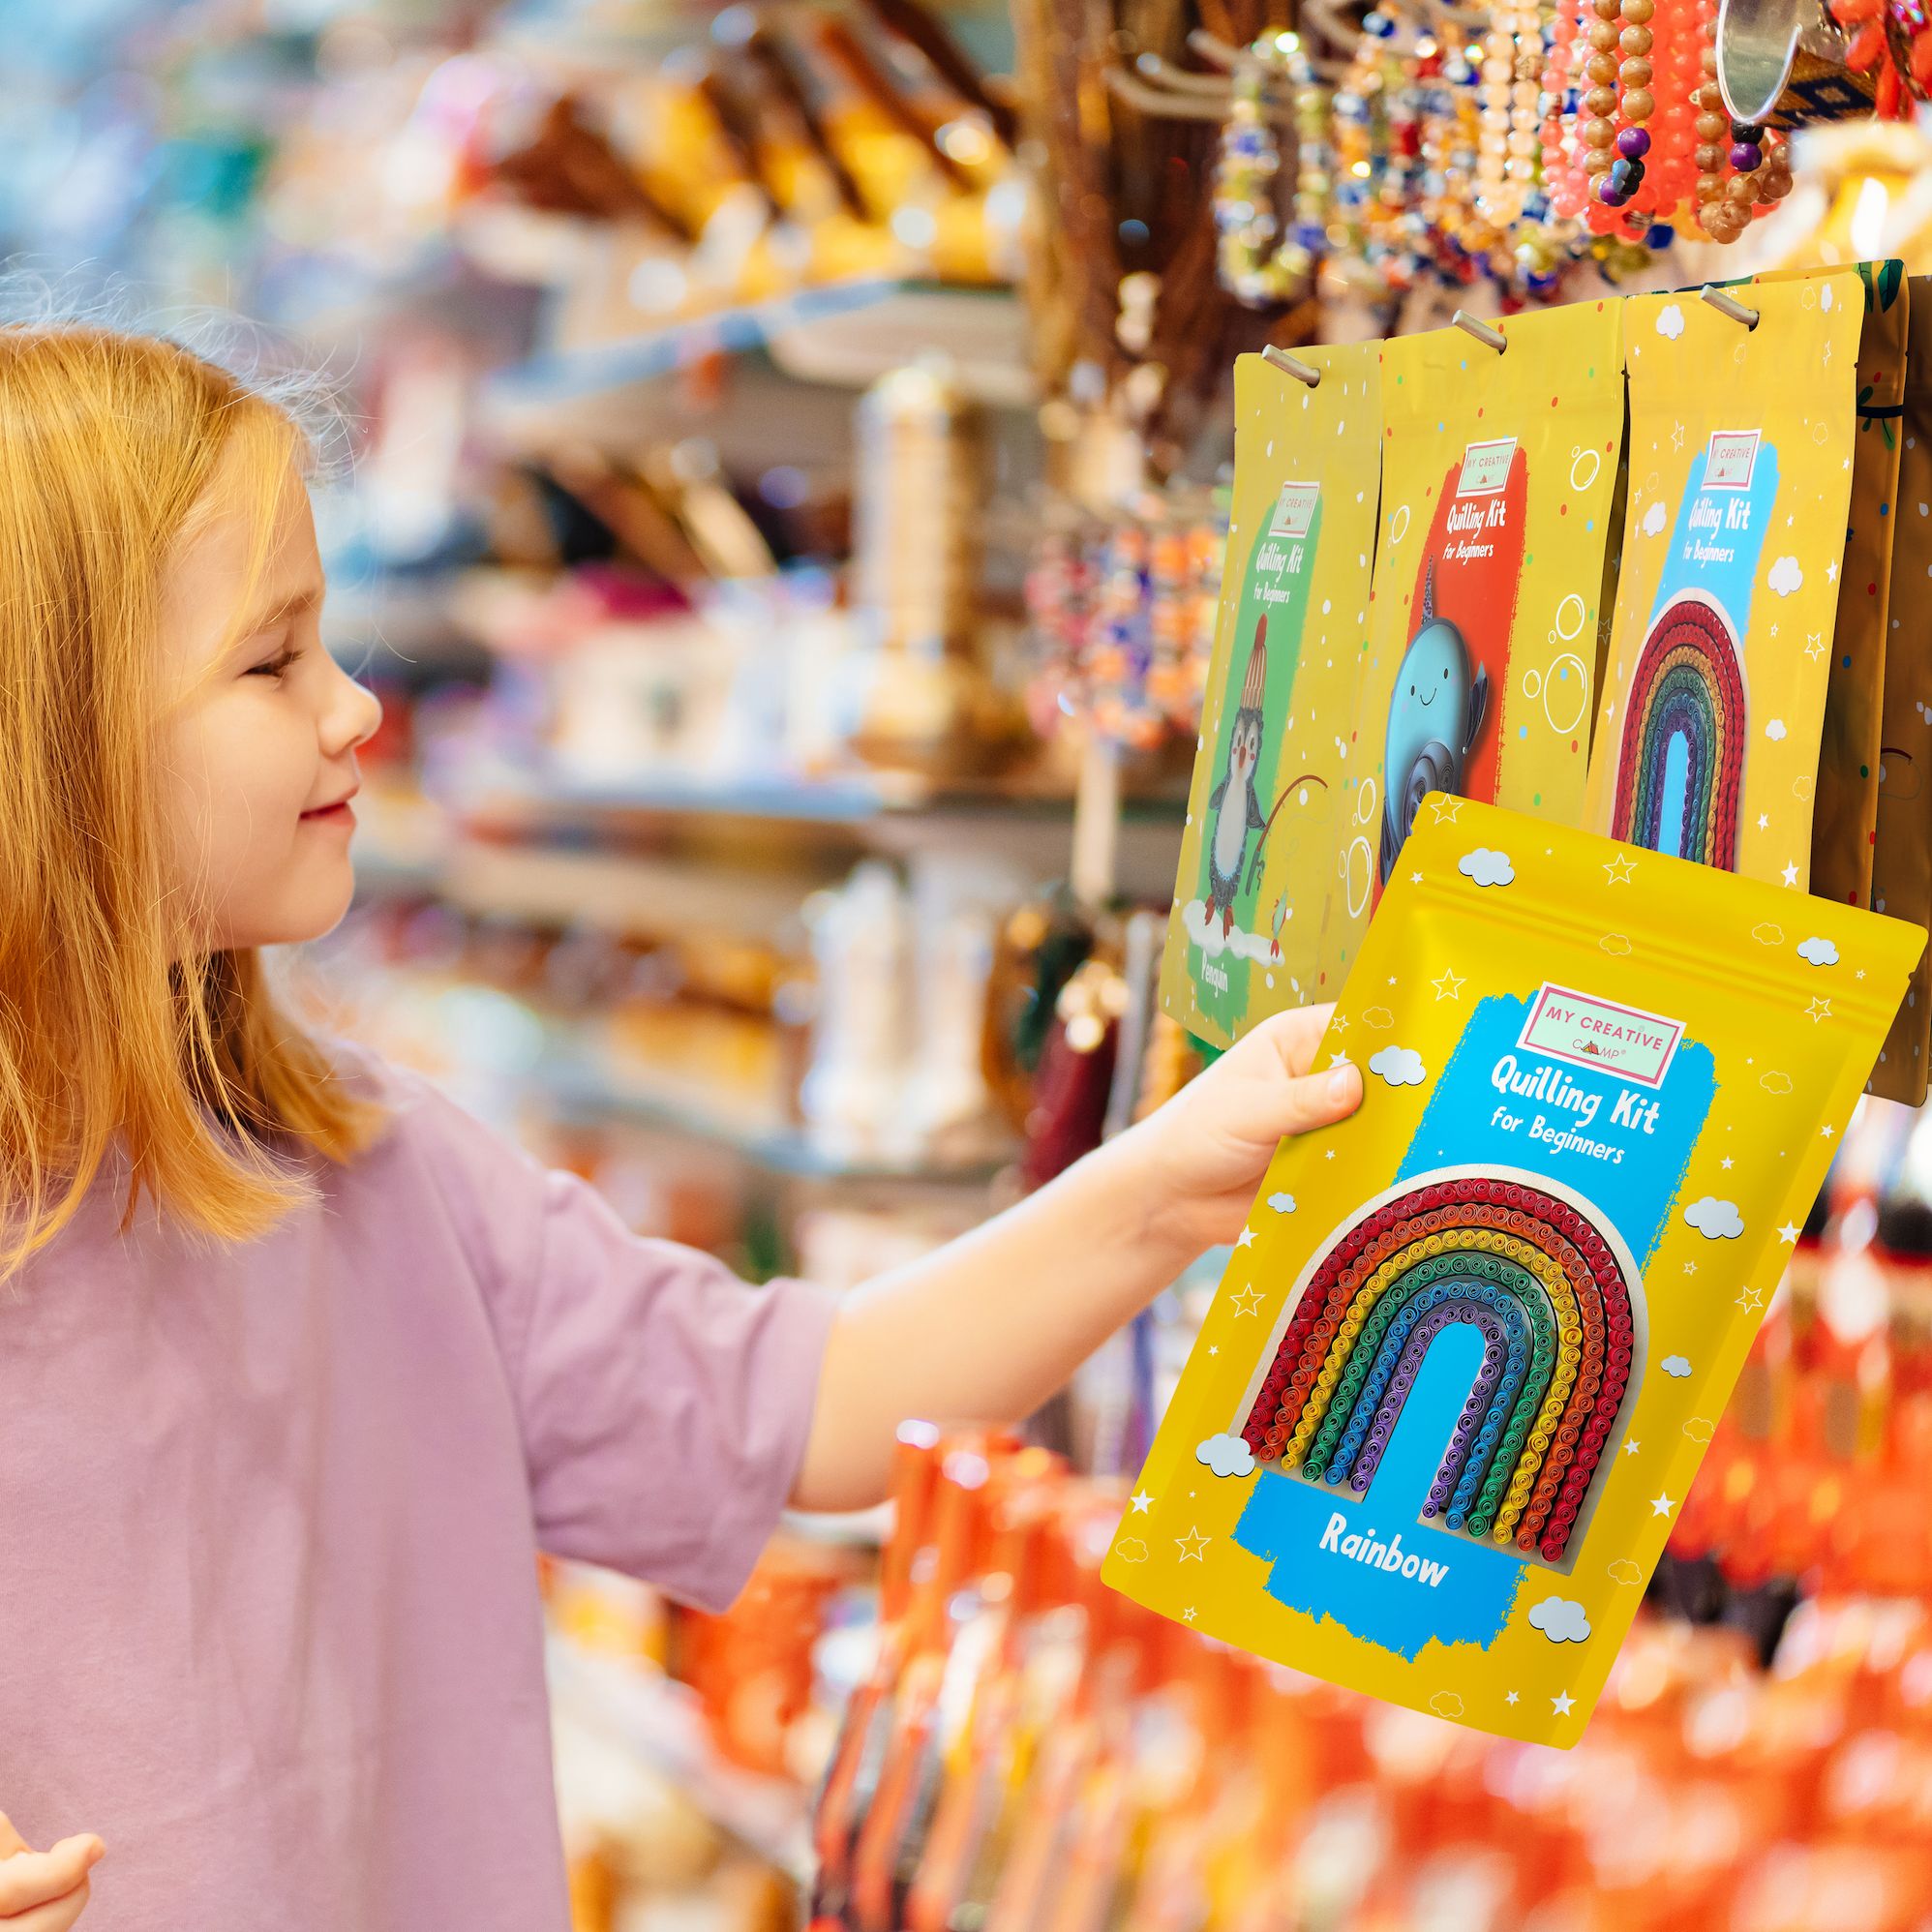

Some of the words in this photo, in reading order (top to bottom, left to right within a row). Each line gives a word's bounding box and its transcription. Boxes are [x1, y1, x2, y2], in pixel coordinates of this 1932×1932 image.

[1479, 455, 1510, 468] CREATIVE
[1447, 502, 1486, 539] Quilling
[1485, 498, 1506, 527] Kit
[1725, 498, 1751, 530] Kit
[1286, 544, 1304, 574] Kit
[1442, 542, 1456, 559] for
[1456, 539, 1494, 566] Beginners
[1693, 538, 1735, 569] Beginners
[1262, 581, 1290, 609] Beginners
[1201, 948, 1228, 998] Penguin
[1546, 1006, 1575, 1023] MY
[1580, 1016, 1664, 1050] CREATIVE
[1491, 1054, 1603, 1128] Quilling
[1610, 1089, 1661, 1135] Kit
[1491, 1105, 1524, 1133] for
[1528, 1114, 1625, 1164] Beginners
[1318, 1511, 1449, 1587] Rainbow
